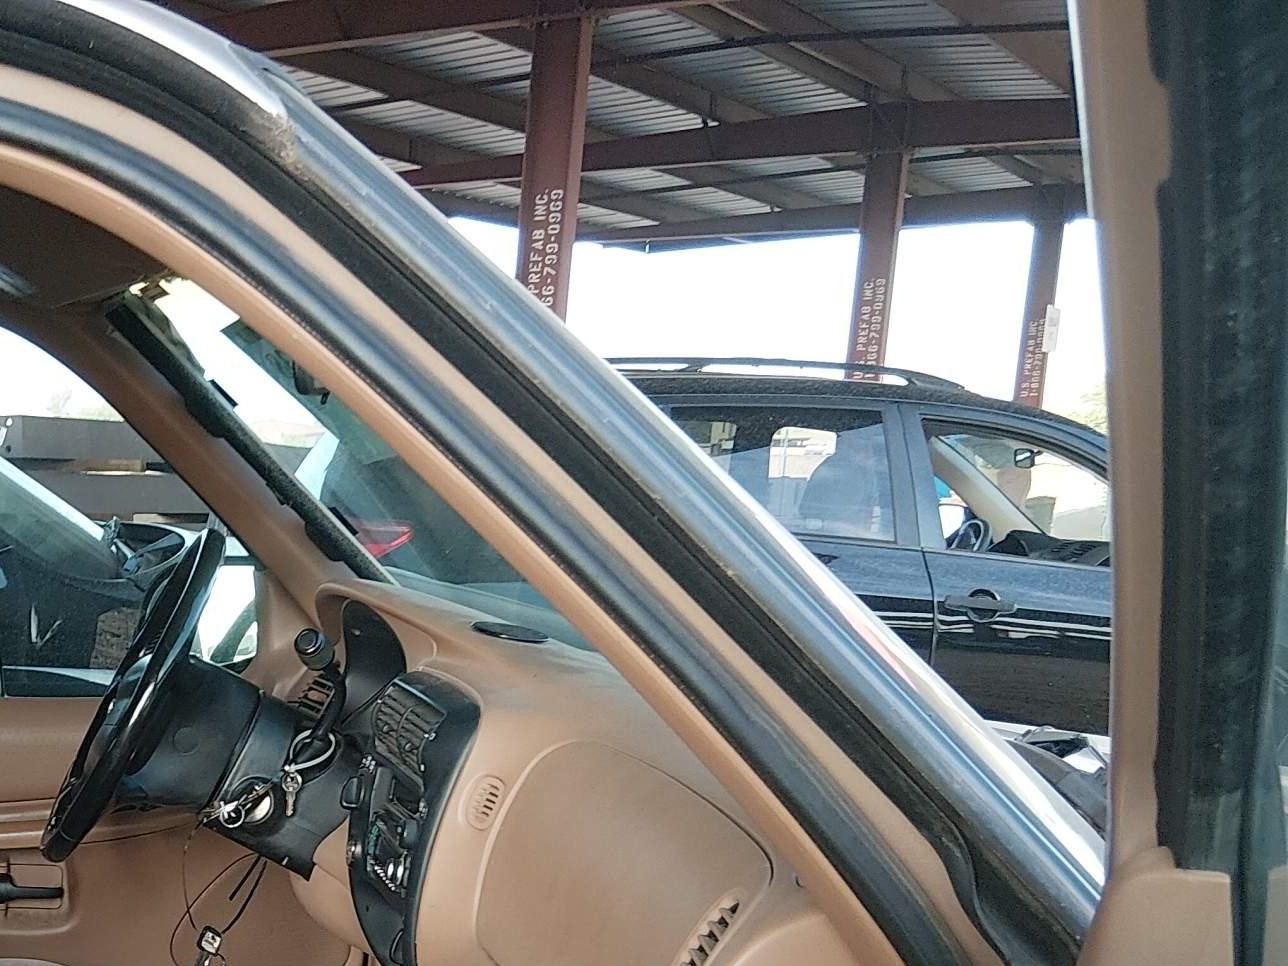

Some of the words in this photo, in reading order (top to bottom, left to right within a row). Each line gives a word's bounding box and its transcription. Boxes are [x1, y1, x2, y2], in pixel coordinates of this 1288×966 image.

[534, 188, 549, 221] INC.
[527, 229, 546, 294] PREFAB
[856, 305, 872, 351] PREFAB
